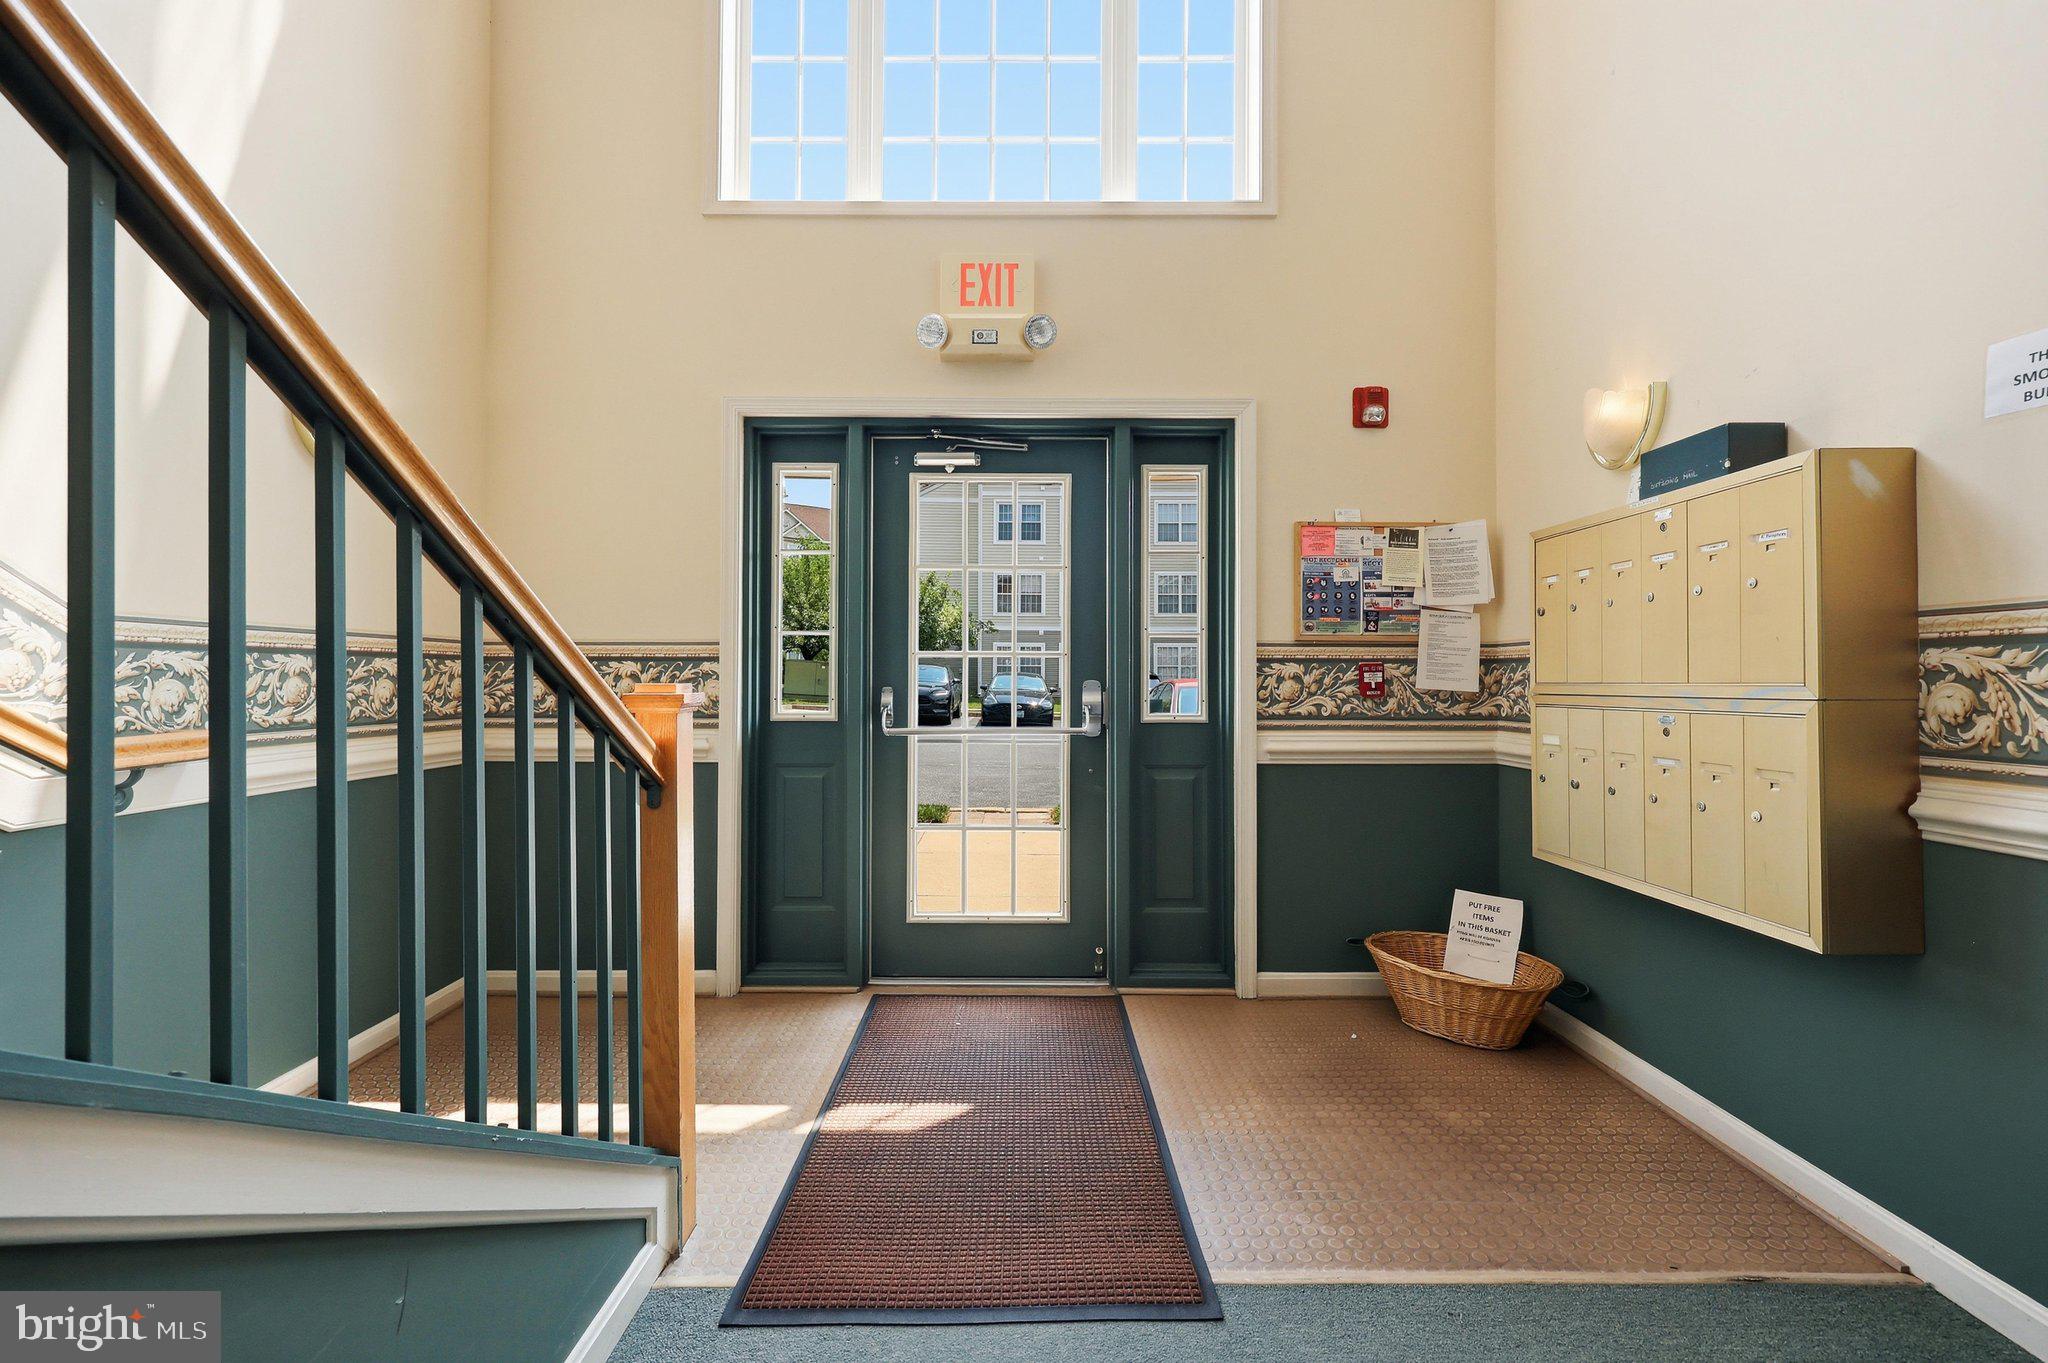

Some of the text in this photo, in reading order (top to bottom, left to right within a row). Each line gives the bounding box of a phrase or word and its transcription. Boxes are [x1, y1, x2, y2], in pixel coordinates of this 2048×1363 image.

[960, 263, 1019, 307] EXIT
[1468, 901, 1501, 913] PUT FREE
[1472, 913, 1494, 922] ITEMS
[1467, 922, 1483, 931] THIS
[1484, 926, 1511, 937] BASKET
